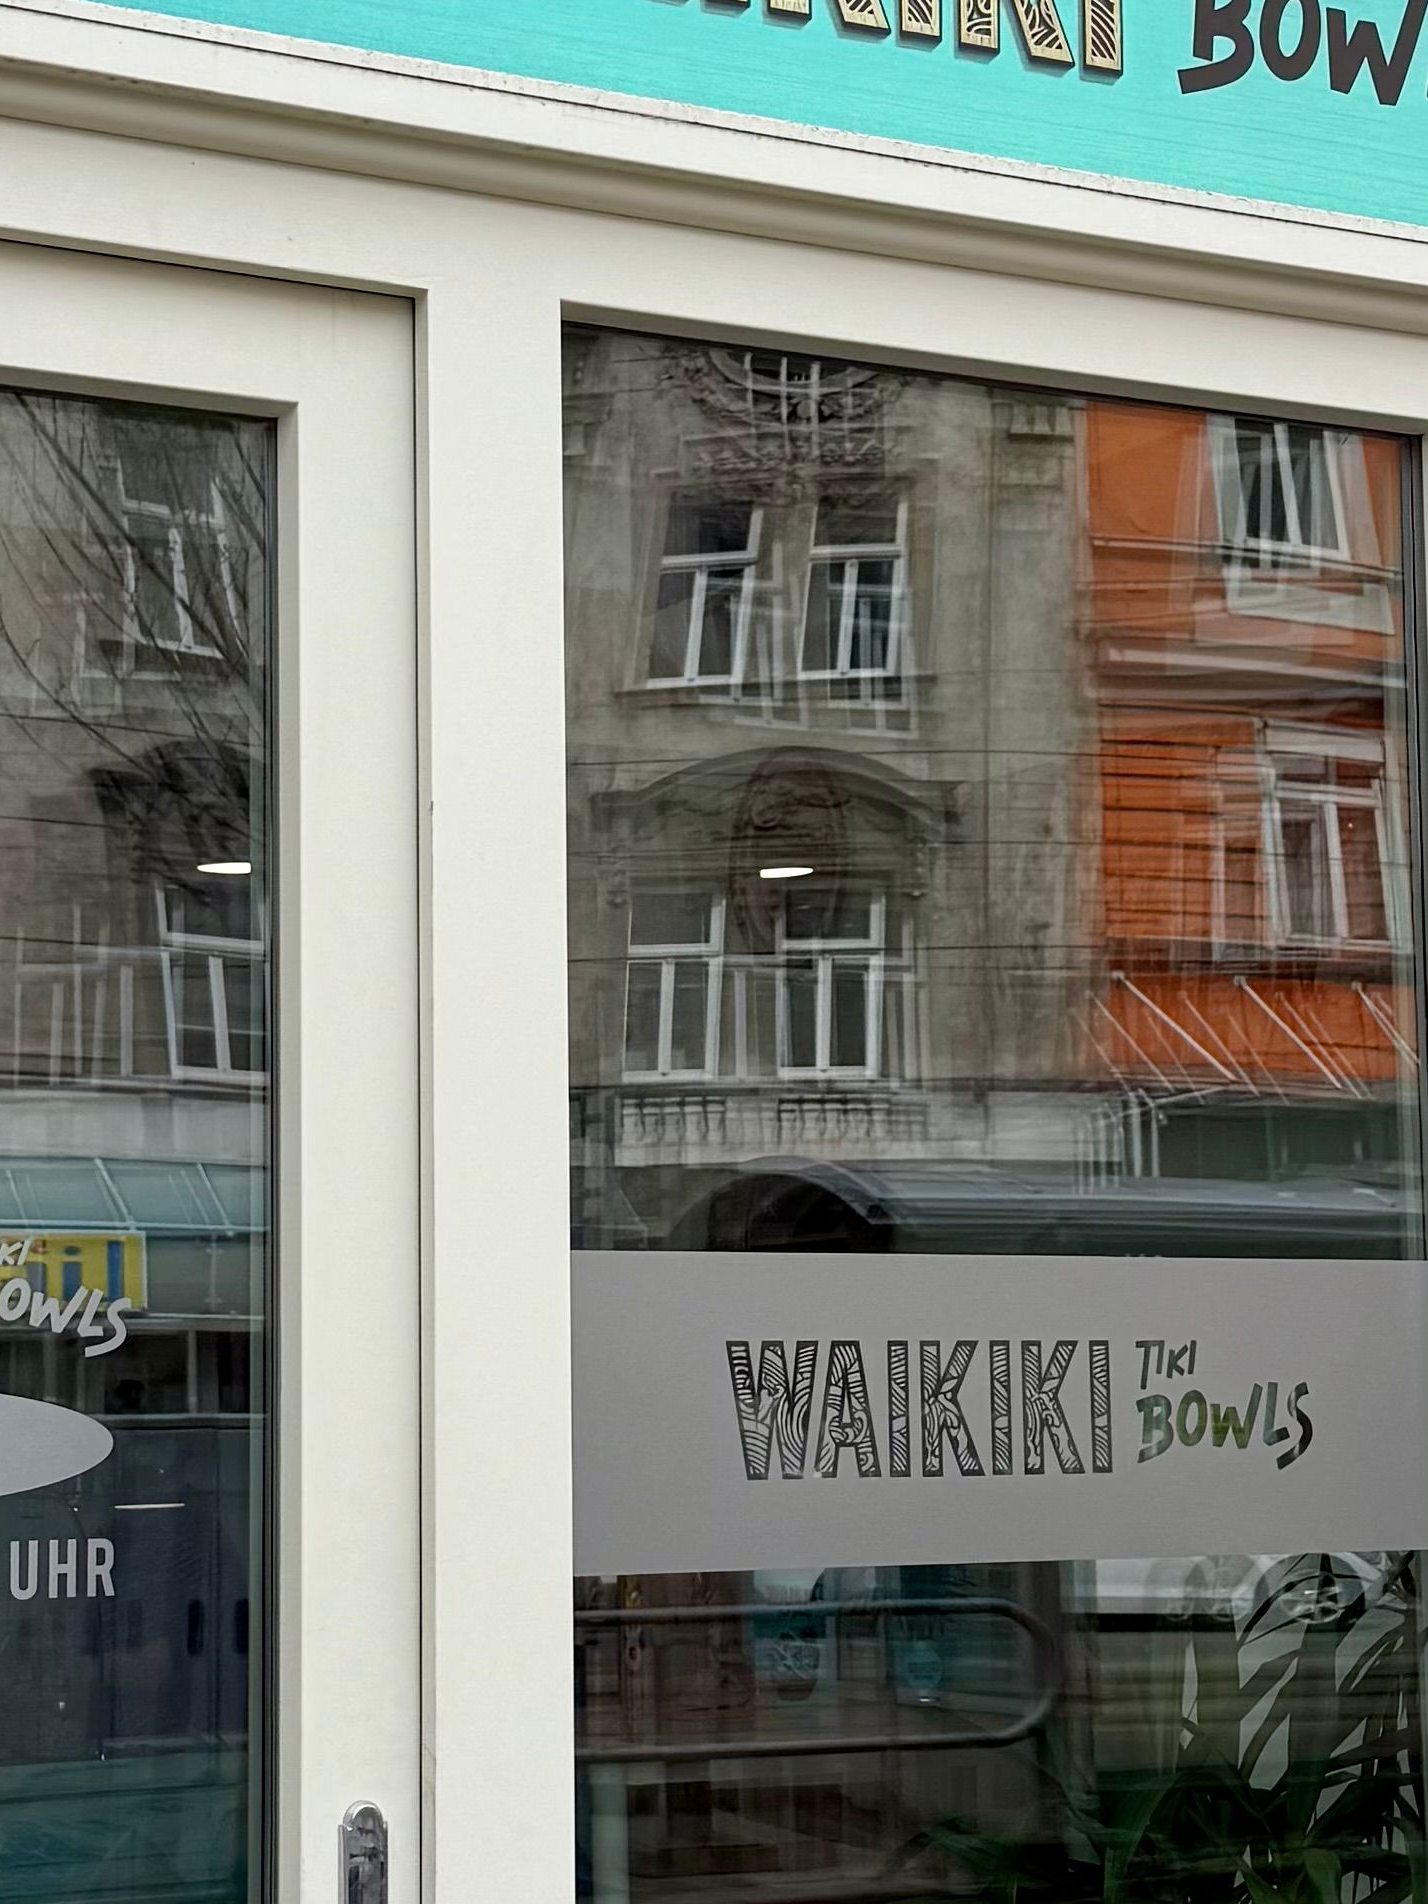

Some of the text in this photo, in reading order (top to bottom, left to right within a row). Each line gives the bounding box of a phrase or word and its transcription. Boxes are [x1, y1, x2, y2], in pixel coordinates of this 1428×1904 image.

[1136, 1339, 1197, 1389] TIKI
[726, 1339, 1112, 1480] WAIKIKI
[1137, 1381, 1310, 1469] BOWLS
